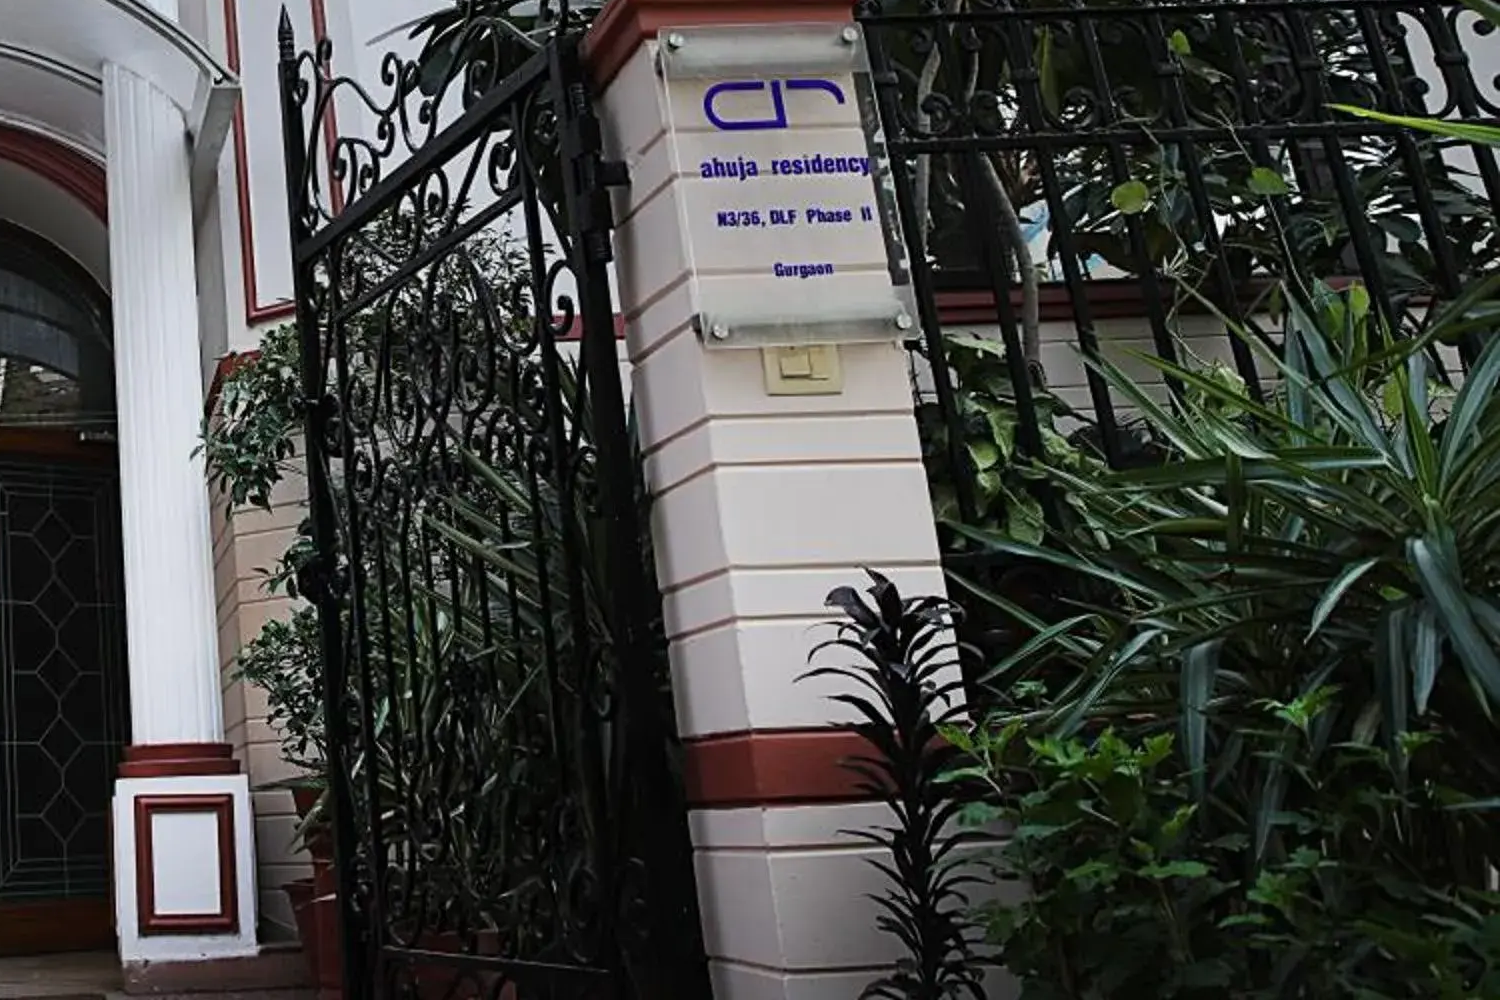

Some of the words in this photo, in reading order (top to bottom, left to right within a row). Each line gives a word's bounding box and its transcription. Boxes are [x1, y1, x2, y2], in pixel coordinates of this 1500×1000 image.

[701, 157, 758, 180] ahuja
[772, 154, 872, 176] residency
[770, 209, 797, 225] DLF
[806, 207, 853, 224] Phase
[774, 262, 834, 279] Gurgaon
